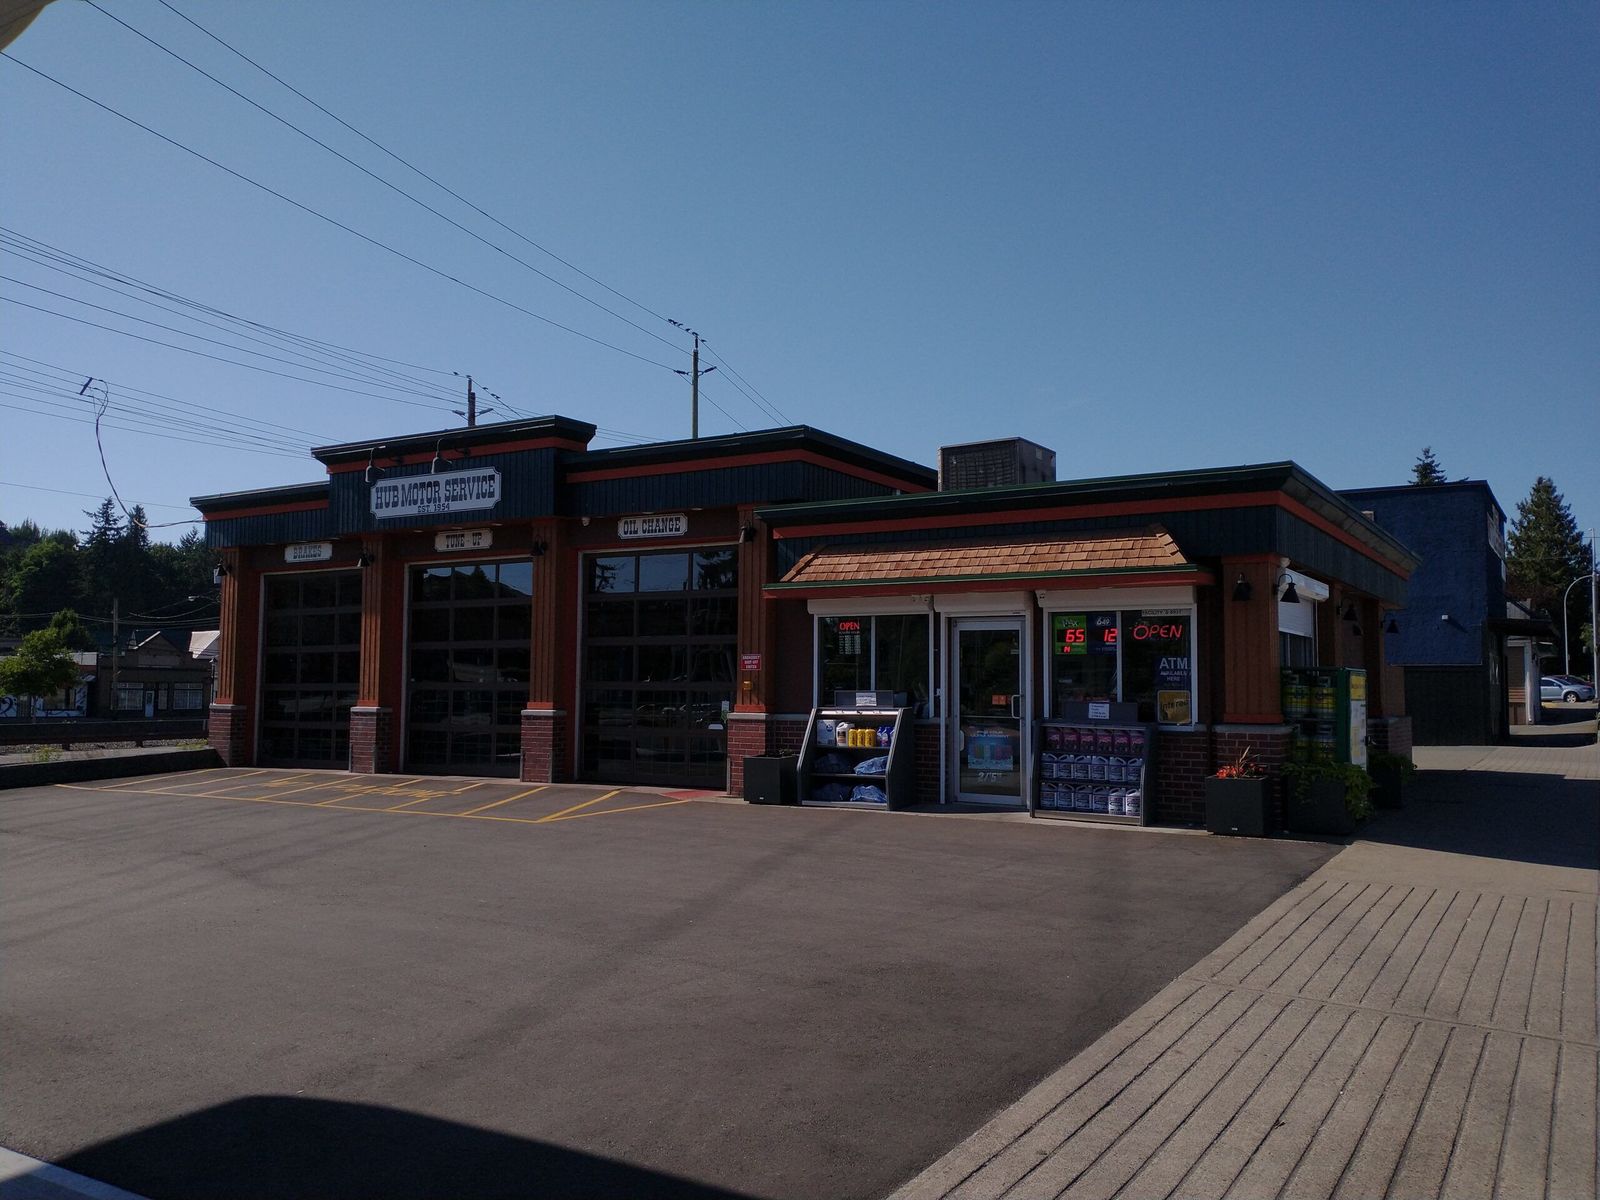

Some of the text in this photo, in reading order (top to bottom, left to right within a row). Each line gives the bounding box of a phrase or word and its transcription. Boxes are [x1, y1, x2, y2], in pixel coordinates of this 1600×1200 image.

[375, 474, 496, 510] HUB MOTOR SERVICE
[417, 502, 450, 513] EST. 1954
[623, 517, 681, 535] OIL CHANGE
[445, 534, 465, 548] TUNE
[472, 532, 482, 546] UP
[293, 545, 322, 559] BRAKES
[839, 621, 860, 631] OPEN
[1133, 624, 1183, 640] OPEN
[1065, 629, 1085, 643] 65
[1103, 628, 1118, 642] 12
[1160, 657, 1188, 669] ATM
